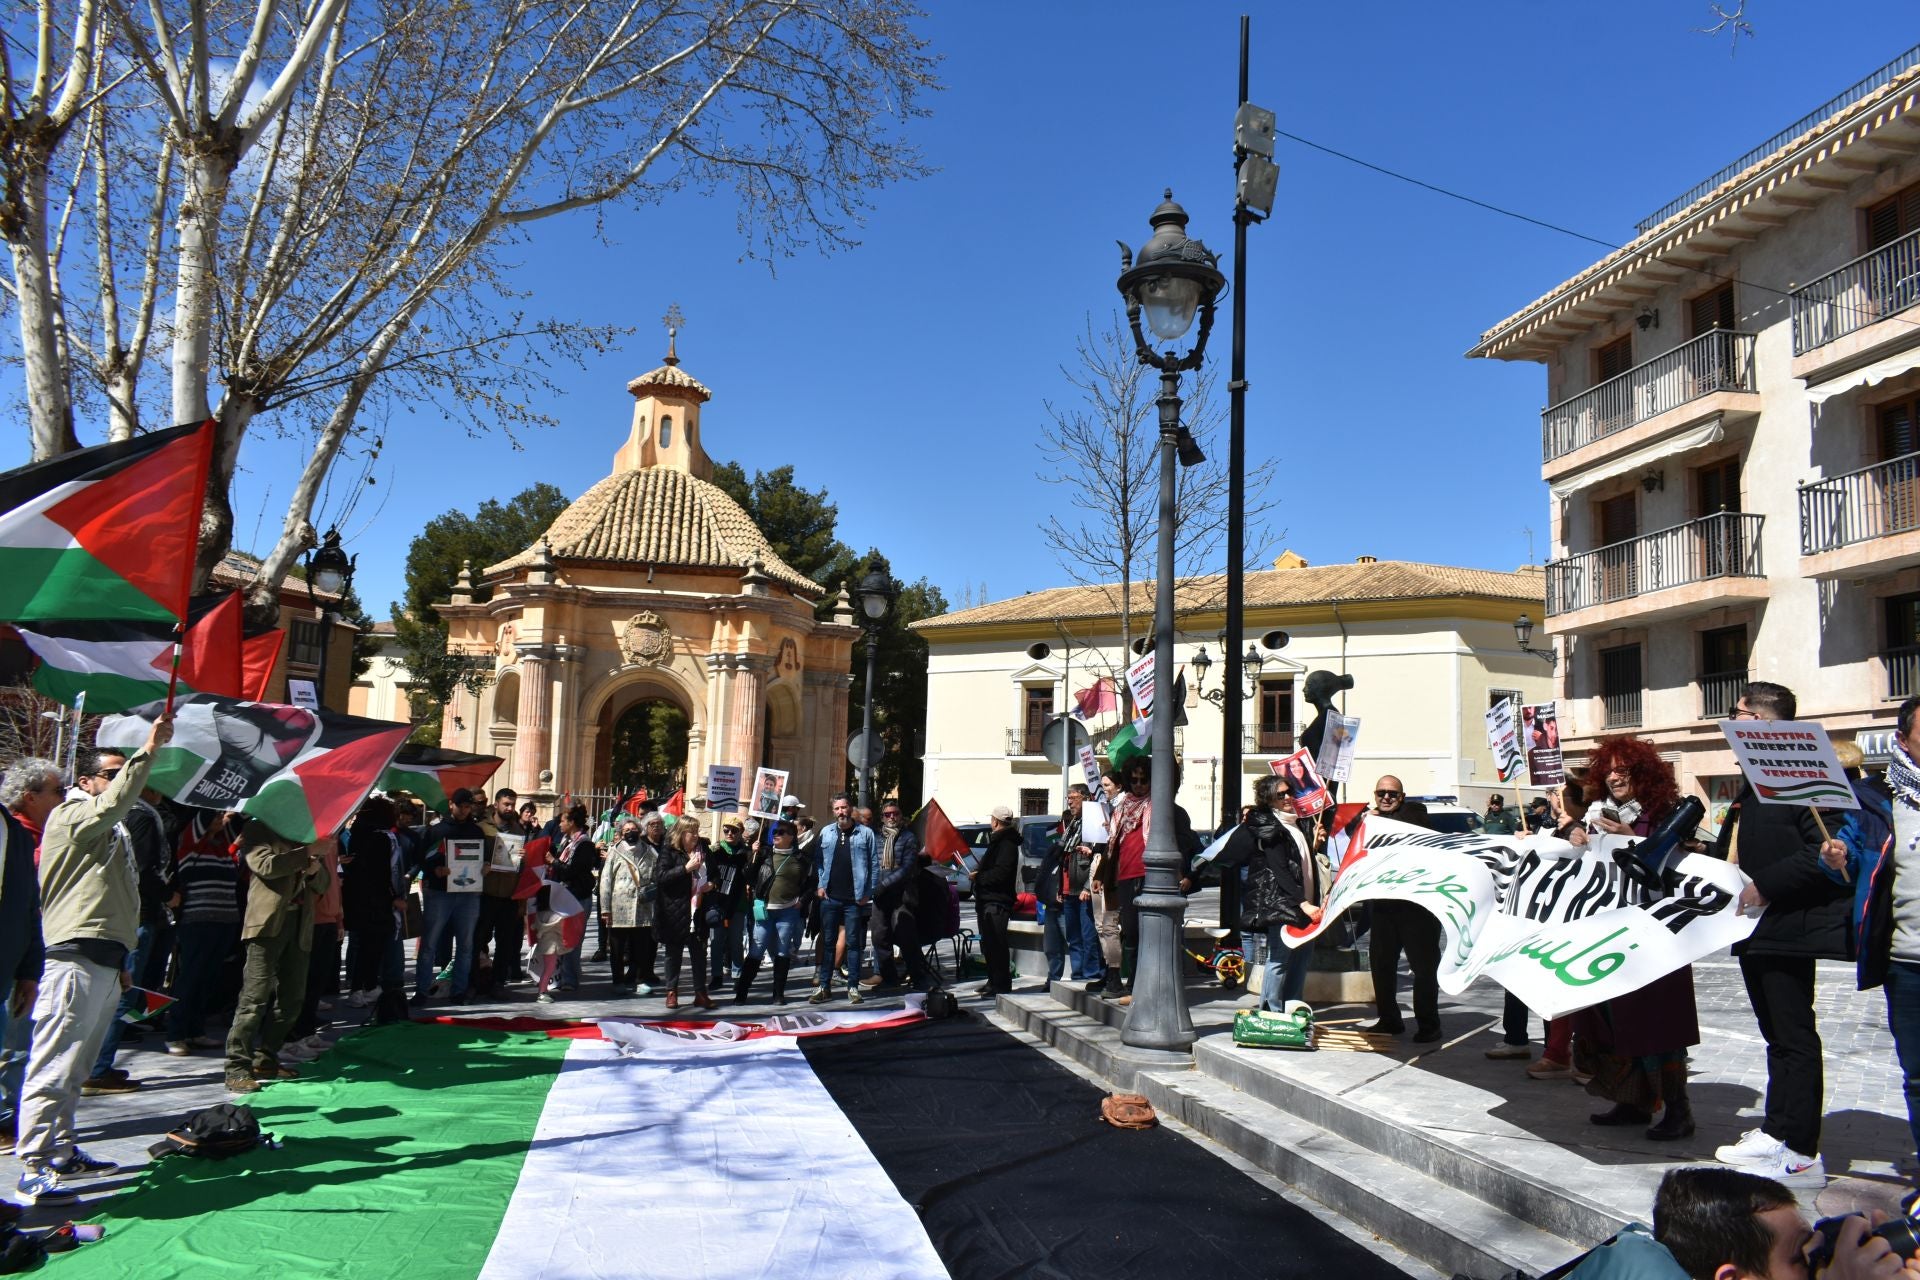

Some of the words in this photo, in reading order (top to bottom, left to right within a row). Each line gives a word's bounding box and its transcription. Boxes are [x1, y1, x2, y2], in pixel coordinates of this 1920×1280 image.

[1735, 731, 1816, 740] PALESTINA
[1743, 742, 1818, 752] LIBERTAD
[1747, 758, 1829, 769] PALESTINA
[1761, 769, 1829, 779] VENCERÁ
